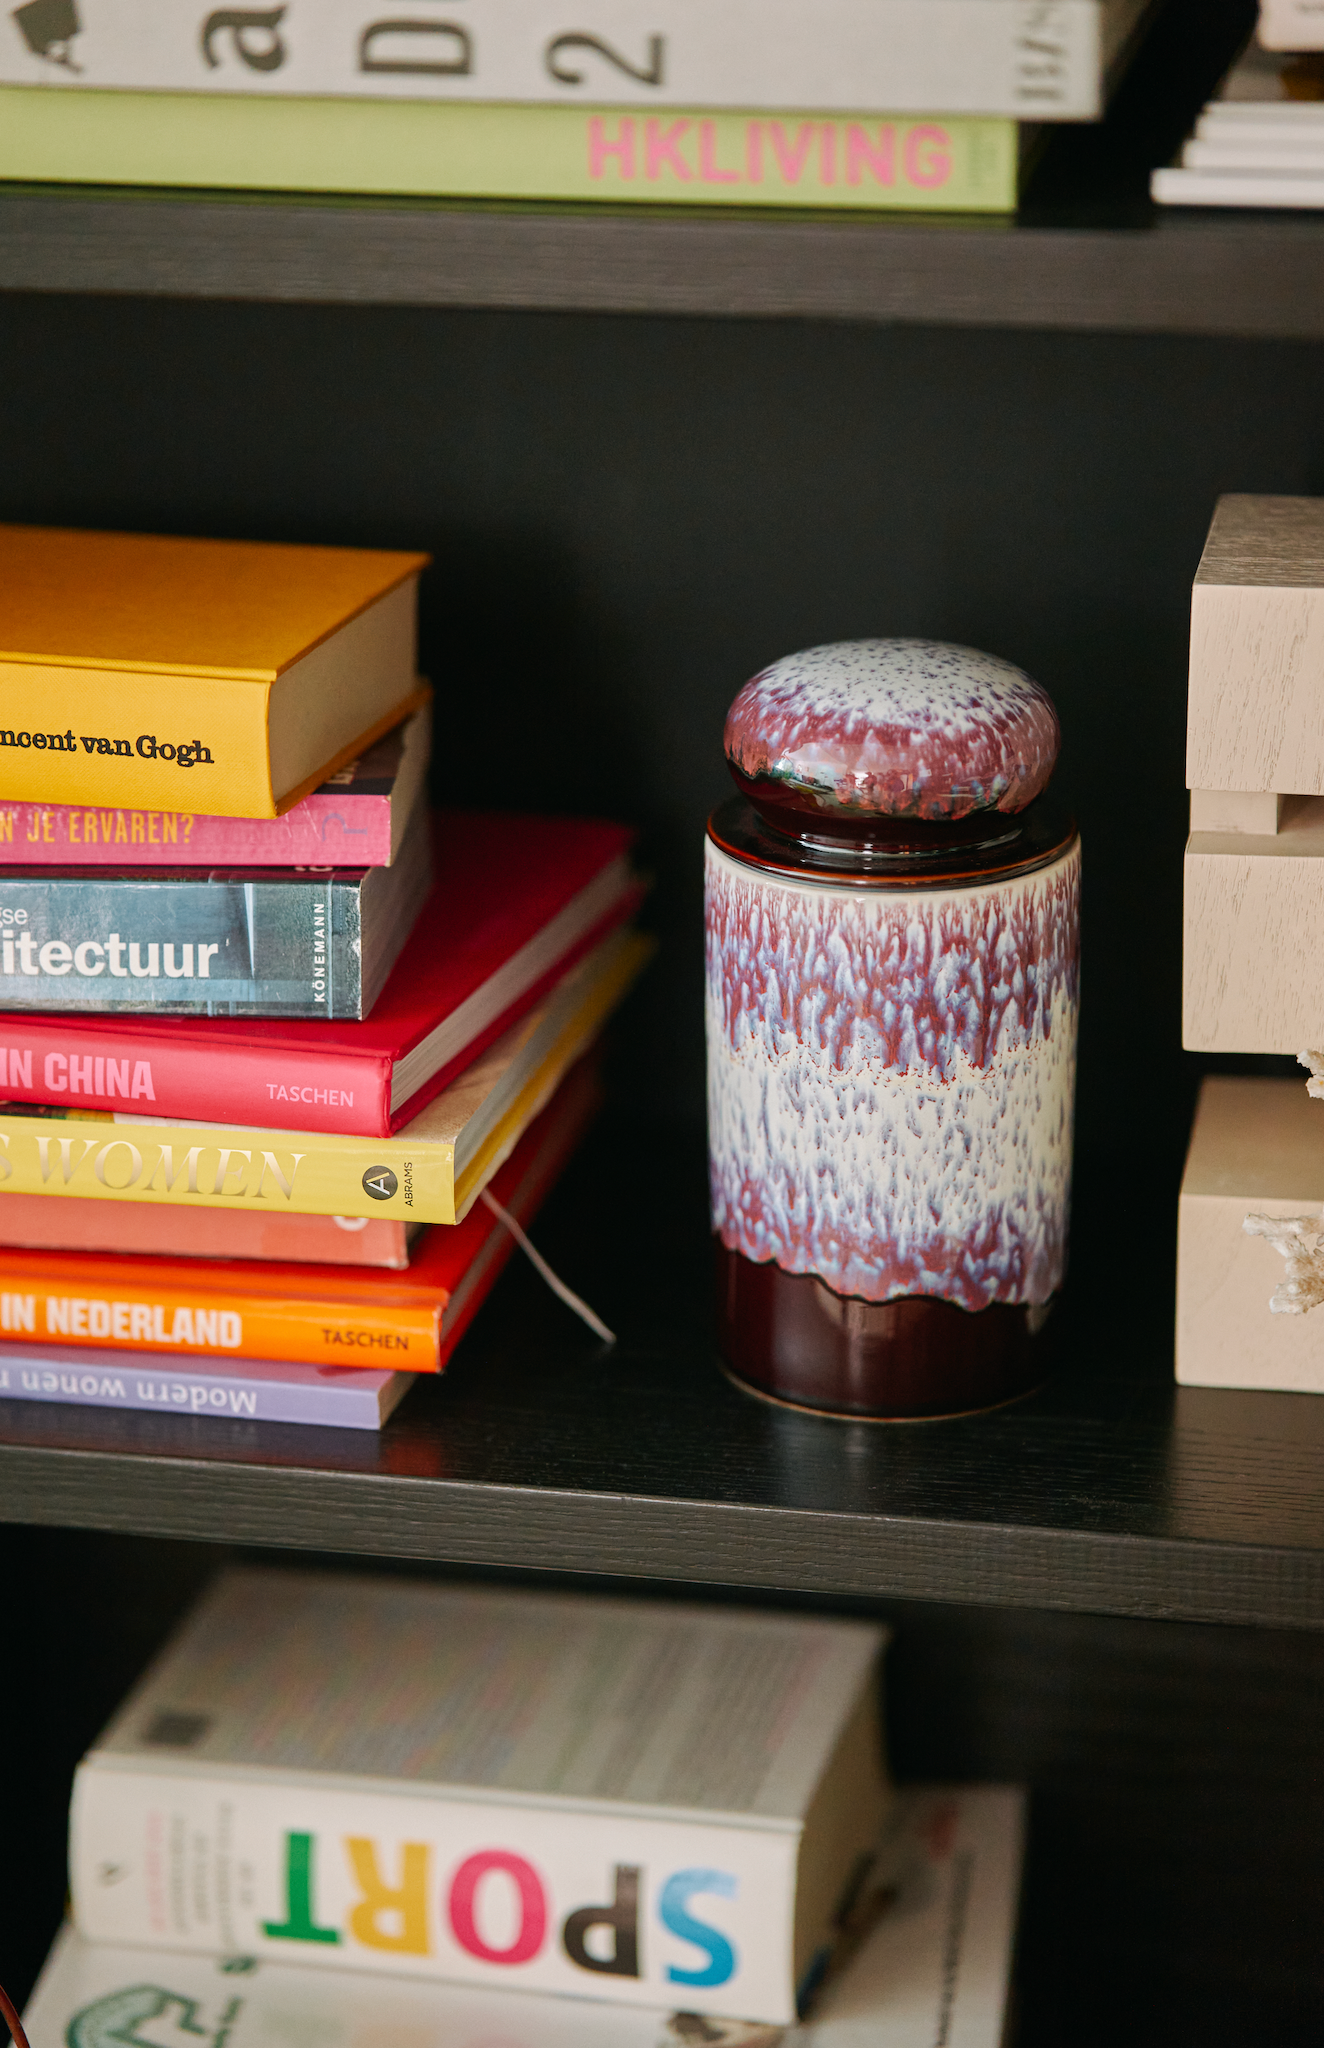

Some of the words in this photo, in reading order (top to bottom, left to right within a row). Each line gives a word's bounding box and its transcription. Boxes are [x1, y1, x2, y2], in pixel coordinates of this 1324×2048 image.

[588, 116, 954, 189] HKLIVING
[80, 736, 134, 757] van
[136, 735, 214, 767] Gogh
[26, 811, 55, 843] JE
[69, 811, 195, 844] ERVAREN?
[0, 907, 28, 928] se
[2, 929, 218, 978] itectuur
[311, 902, 325, 1003] KÖNEMANN
[0, 1048, 33, 1089] IN
[44, 1052, 156, 1100] CHINA
[266, 1084, 354, 1108] TASCHEN
[34, 1136, 307, 1201] WOMEN
[405, 1162, 413, 1207] ABRAMS
[1, 1293, 36, 1332] IN
[46, 1295, 242, 1349] NEDERLAND
[321, 1328, 409, 1351] TASCHEN
[22, 1370, 126, 1400] wonen
[137, 1379, 257, 1414] Modern
[262, 1830, 740, 1990] SPORT
